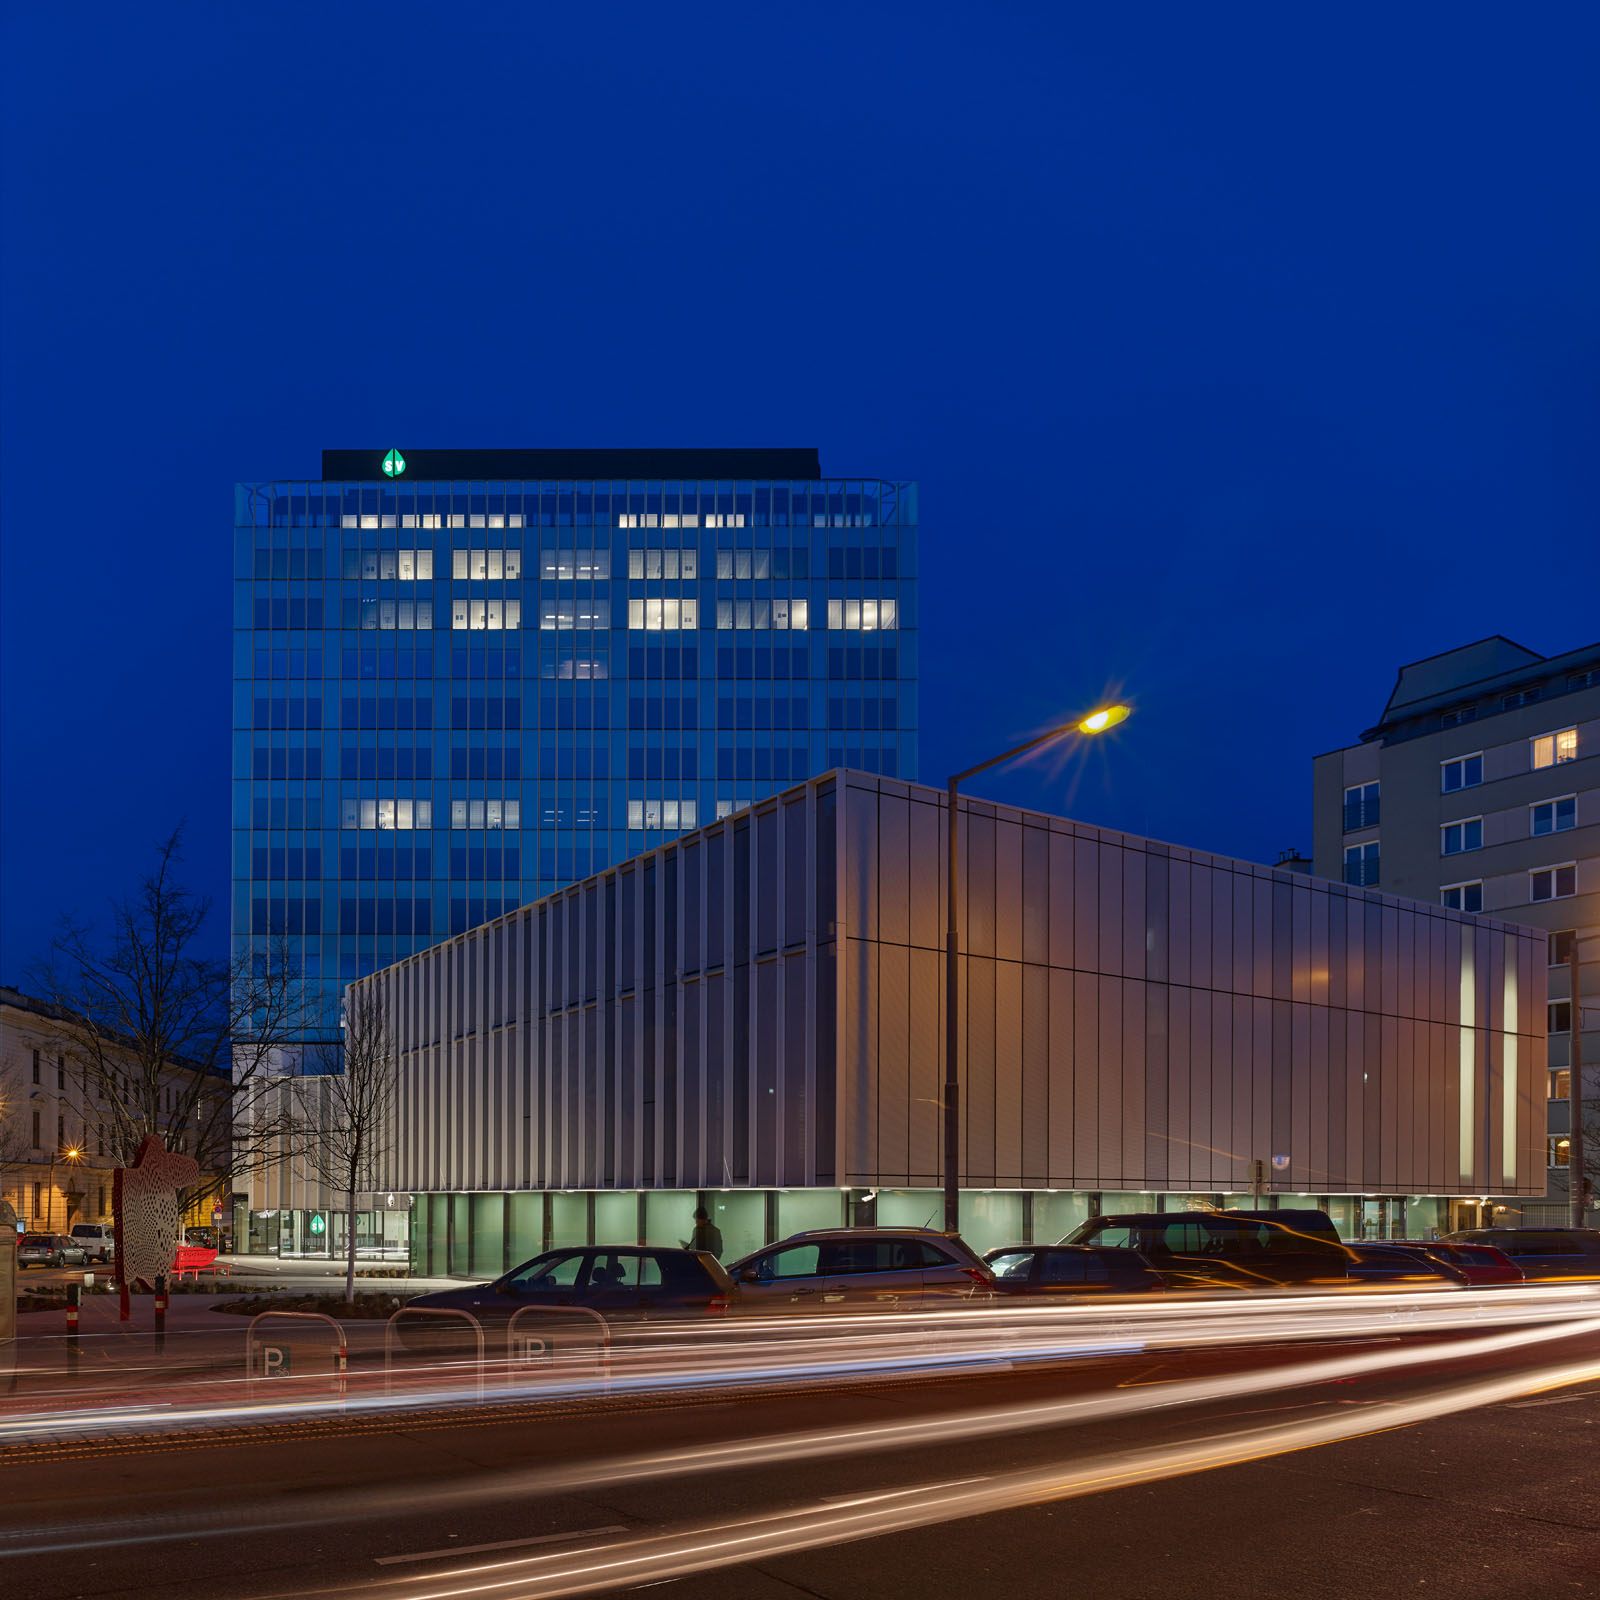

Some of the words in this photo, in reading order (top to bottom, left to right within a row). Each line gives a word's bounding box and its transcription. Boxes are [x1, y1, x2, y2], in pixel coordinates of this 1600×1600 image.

[385, 460, 404, 472] SV
[265, 1348, 283, 1376] P
[527, 1338, 545, 1364] P
